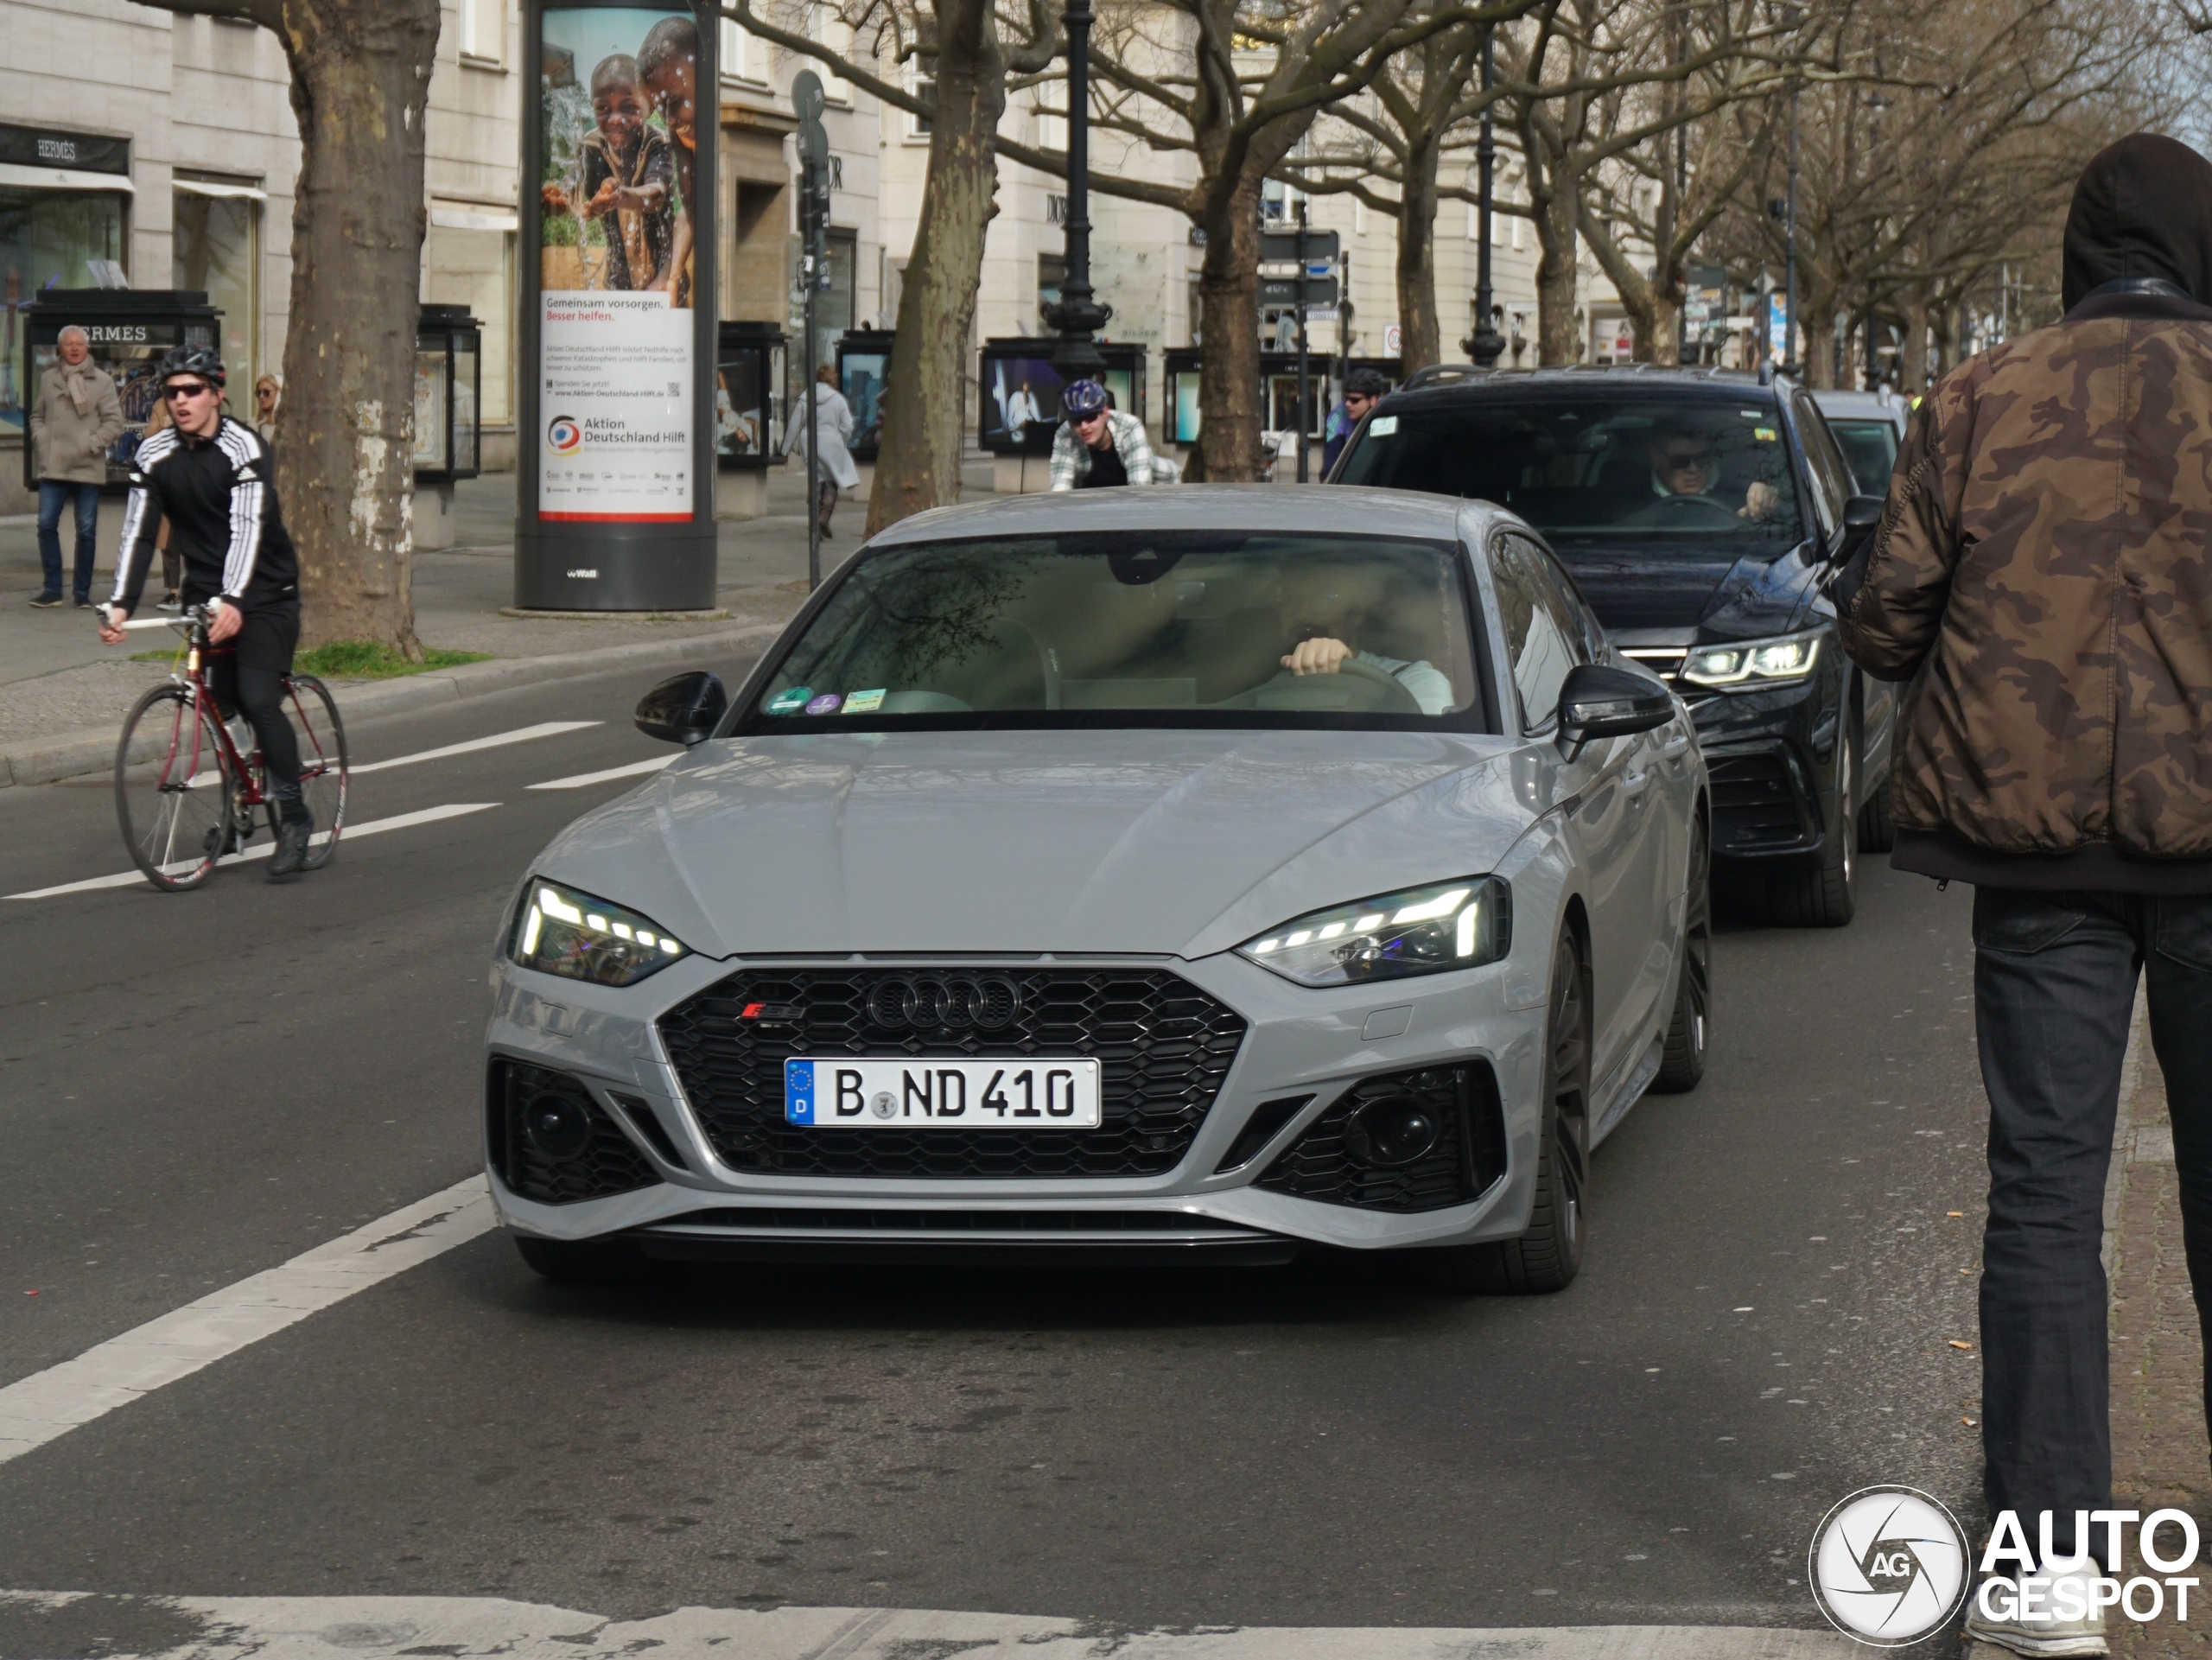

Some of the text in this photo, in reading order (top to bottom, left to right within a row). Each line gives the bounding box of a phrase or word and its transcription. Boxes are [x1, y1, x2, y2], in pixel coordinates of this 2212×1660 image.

[826, 155, 842, 189] OR
[547, 297, 664, 311] Gemeinsam vorsorgen.
[547, 311, 614, 321] Besser helfen.
[574, 355, 617, 364] Katastrophen
[555, 380, 580, 389] Spenden
[592, 380, 609, 389] jetzt!
[584, 418, 625, 429] Aktion
[584, 432, 685, 443] Deutschland Hilft
[787, 690, 798, 701] 4
[836, 1069, 1074, 1116] B ND 410
[795, 1099, 806, 1114] D
